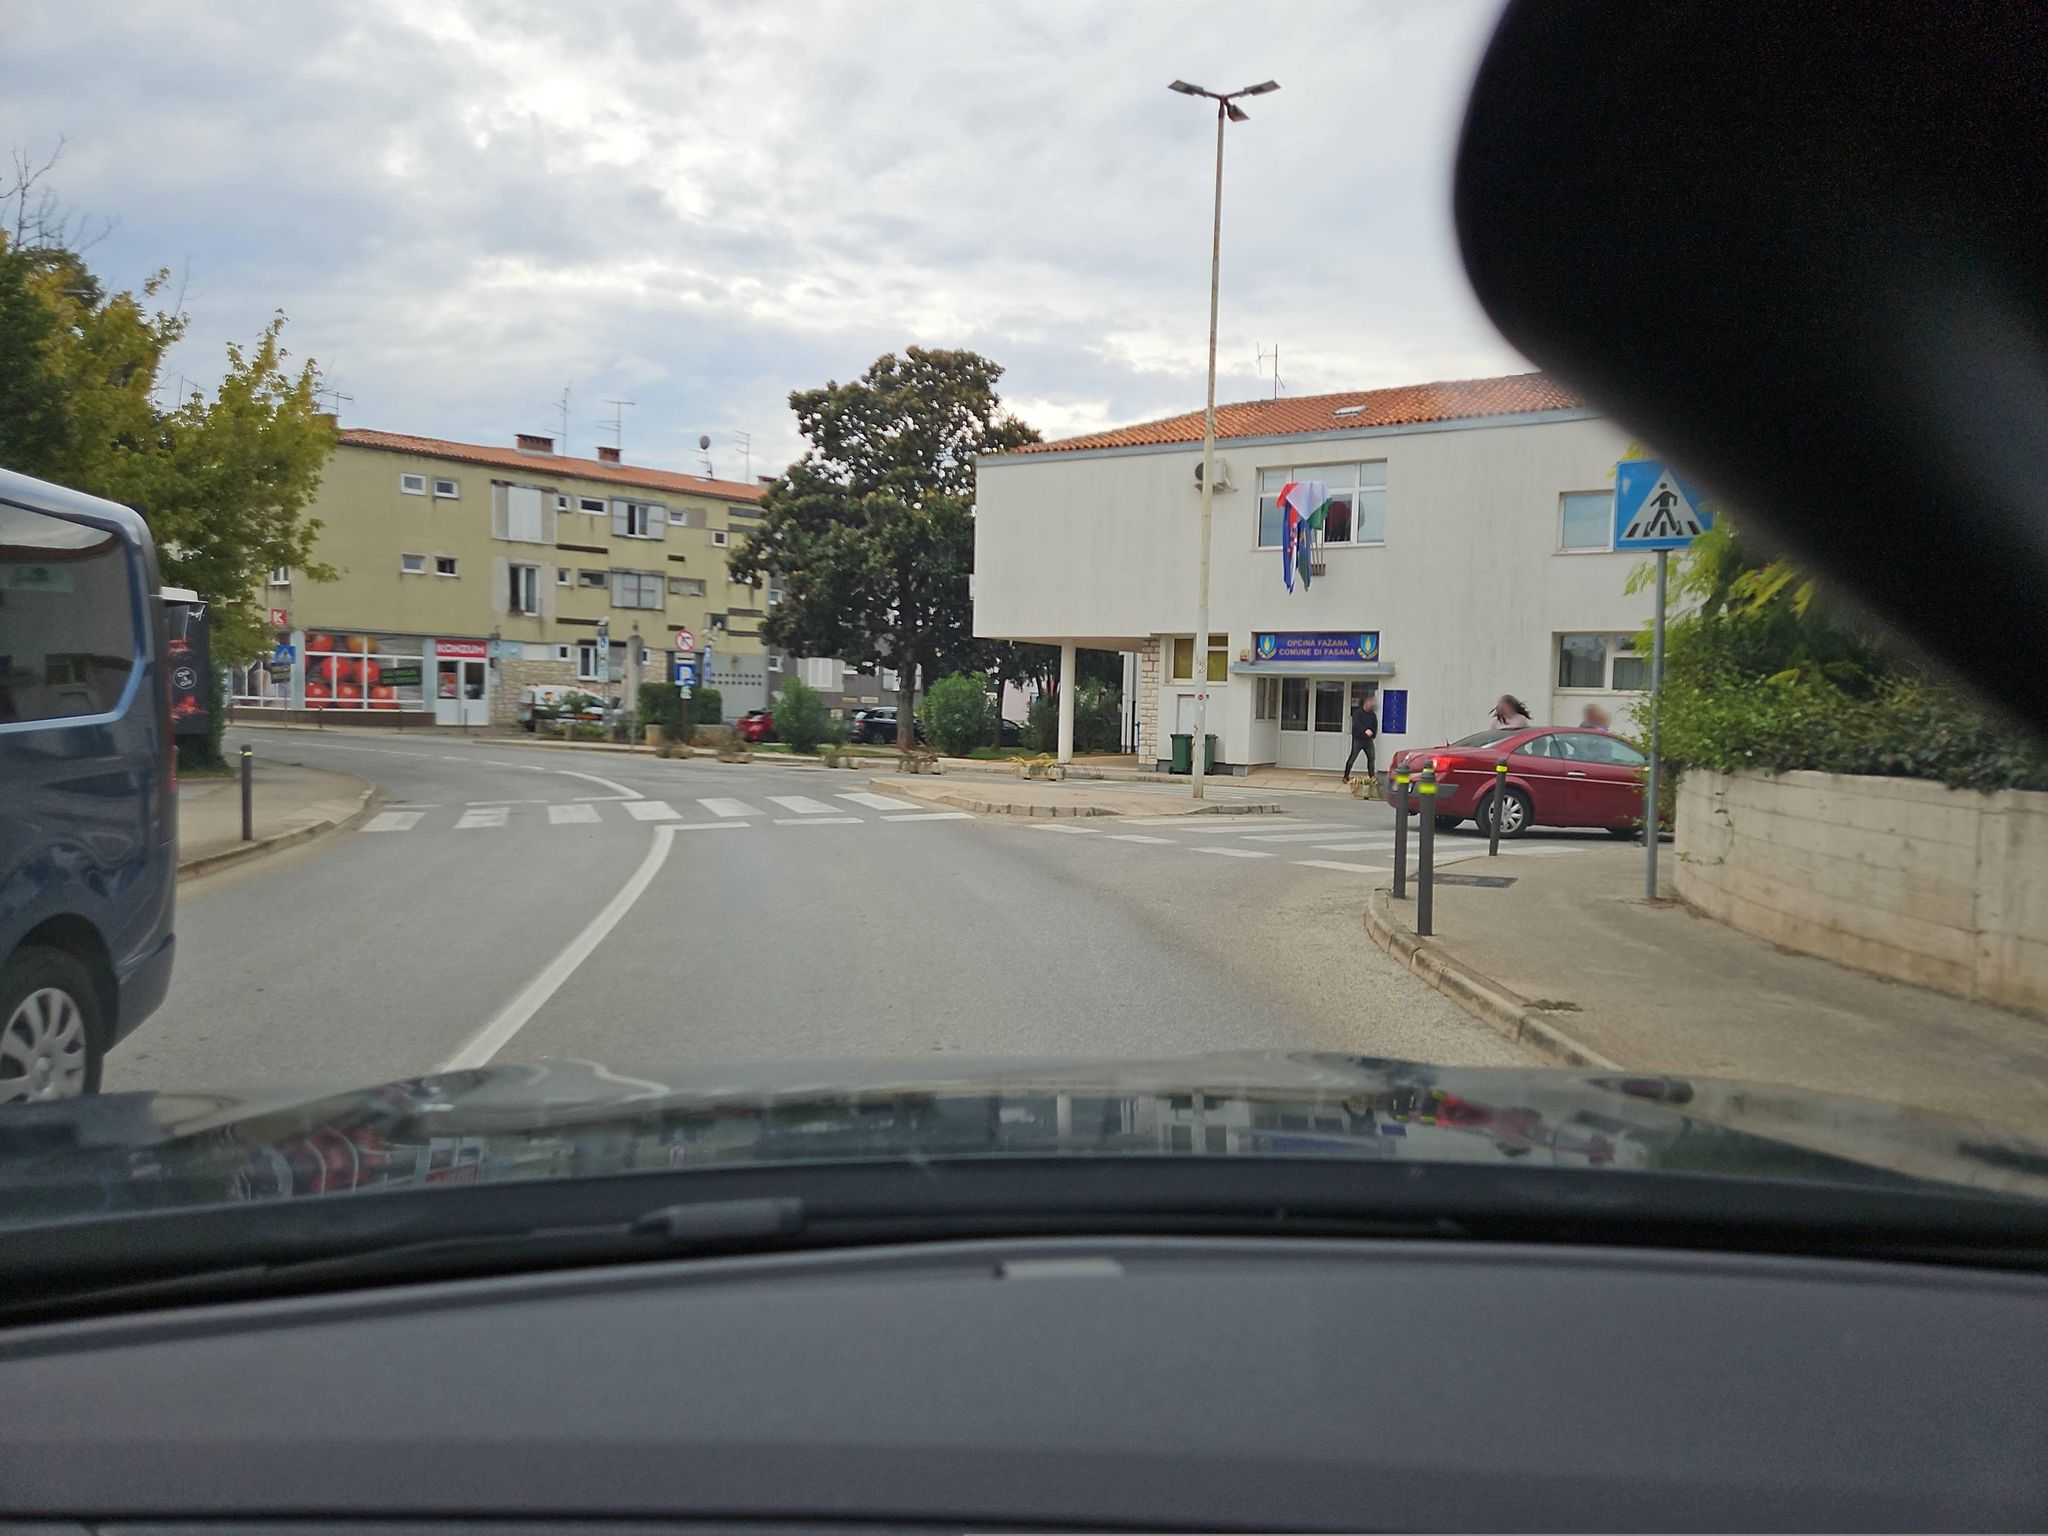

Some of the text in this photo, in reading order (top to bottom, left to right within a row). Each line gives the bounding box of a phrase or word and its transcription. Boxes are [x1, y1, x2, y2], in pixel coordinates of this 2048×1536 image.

[273, 610, 285, 624] K
[1317, 638, 1348, 647] FAŽANA
[437, 643, 484, 654] KONZUM
[1278, 648, 1355, 656] COMUNE DI FASANA
